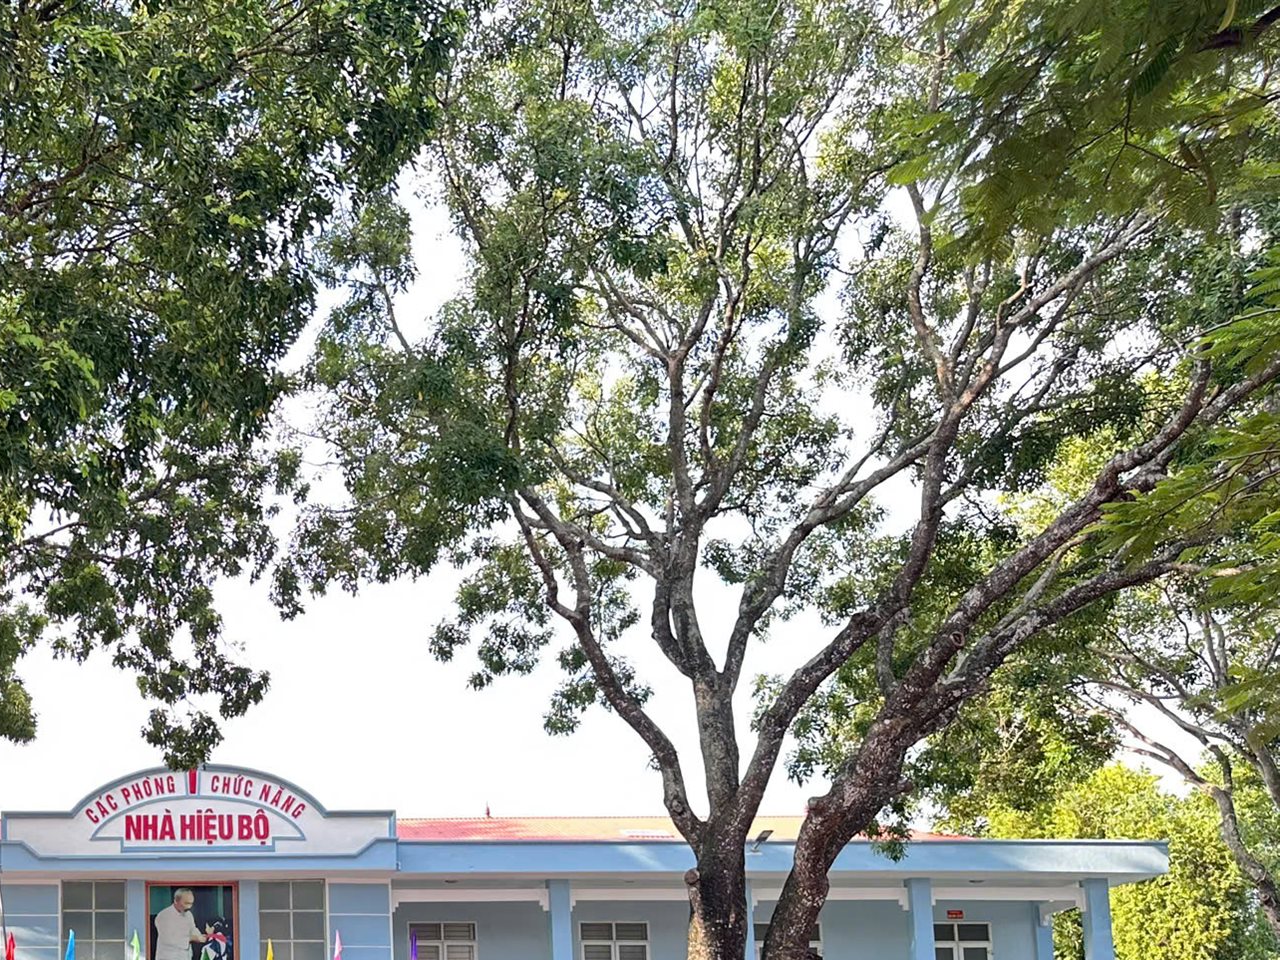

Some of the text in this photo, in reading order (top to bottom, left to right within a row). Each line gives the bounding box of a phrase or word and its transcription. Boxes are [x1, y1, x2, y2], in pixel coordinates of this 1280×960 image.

[85, 774, 306, 824] CÁC PHÒNG CHỨC NĂNG
[125, 808, 270, 845] NHÀ HIỆU BỘ
